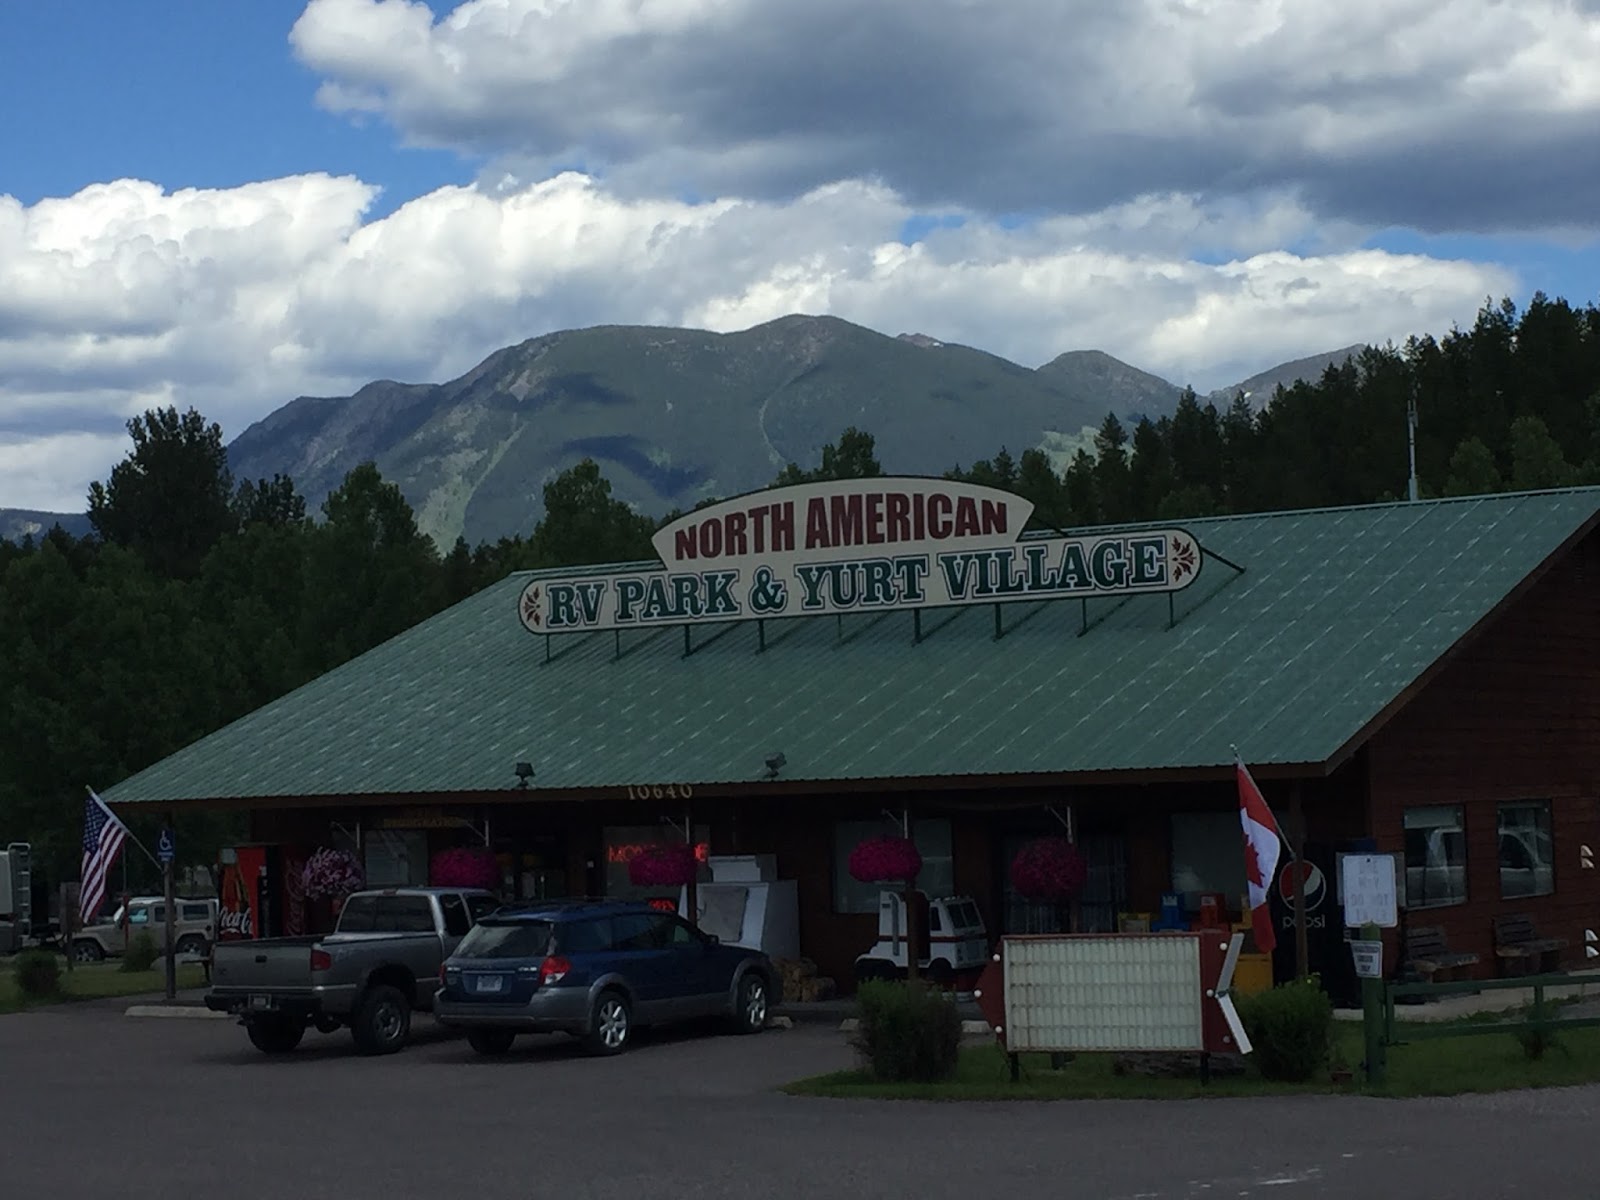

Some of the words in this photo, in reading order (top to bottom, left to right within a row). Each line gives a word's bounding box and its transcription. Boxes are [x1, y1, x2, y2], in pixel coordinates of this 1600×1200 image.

[674, 501, 795, 561] NORTH
[804, 493, 1008, 550] AMERICAN
[546, 579, 608, 629] RV
[614, 569, 742, 624] PARK
[749, 565, 788, 615] &
[794, 553, 929, 610] YURT
[937, 535, 1169, 600] VILLAGE
[627, 784, 693, 800] 10640
